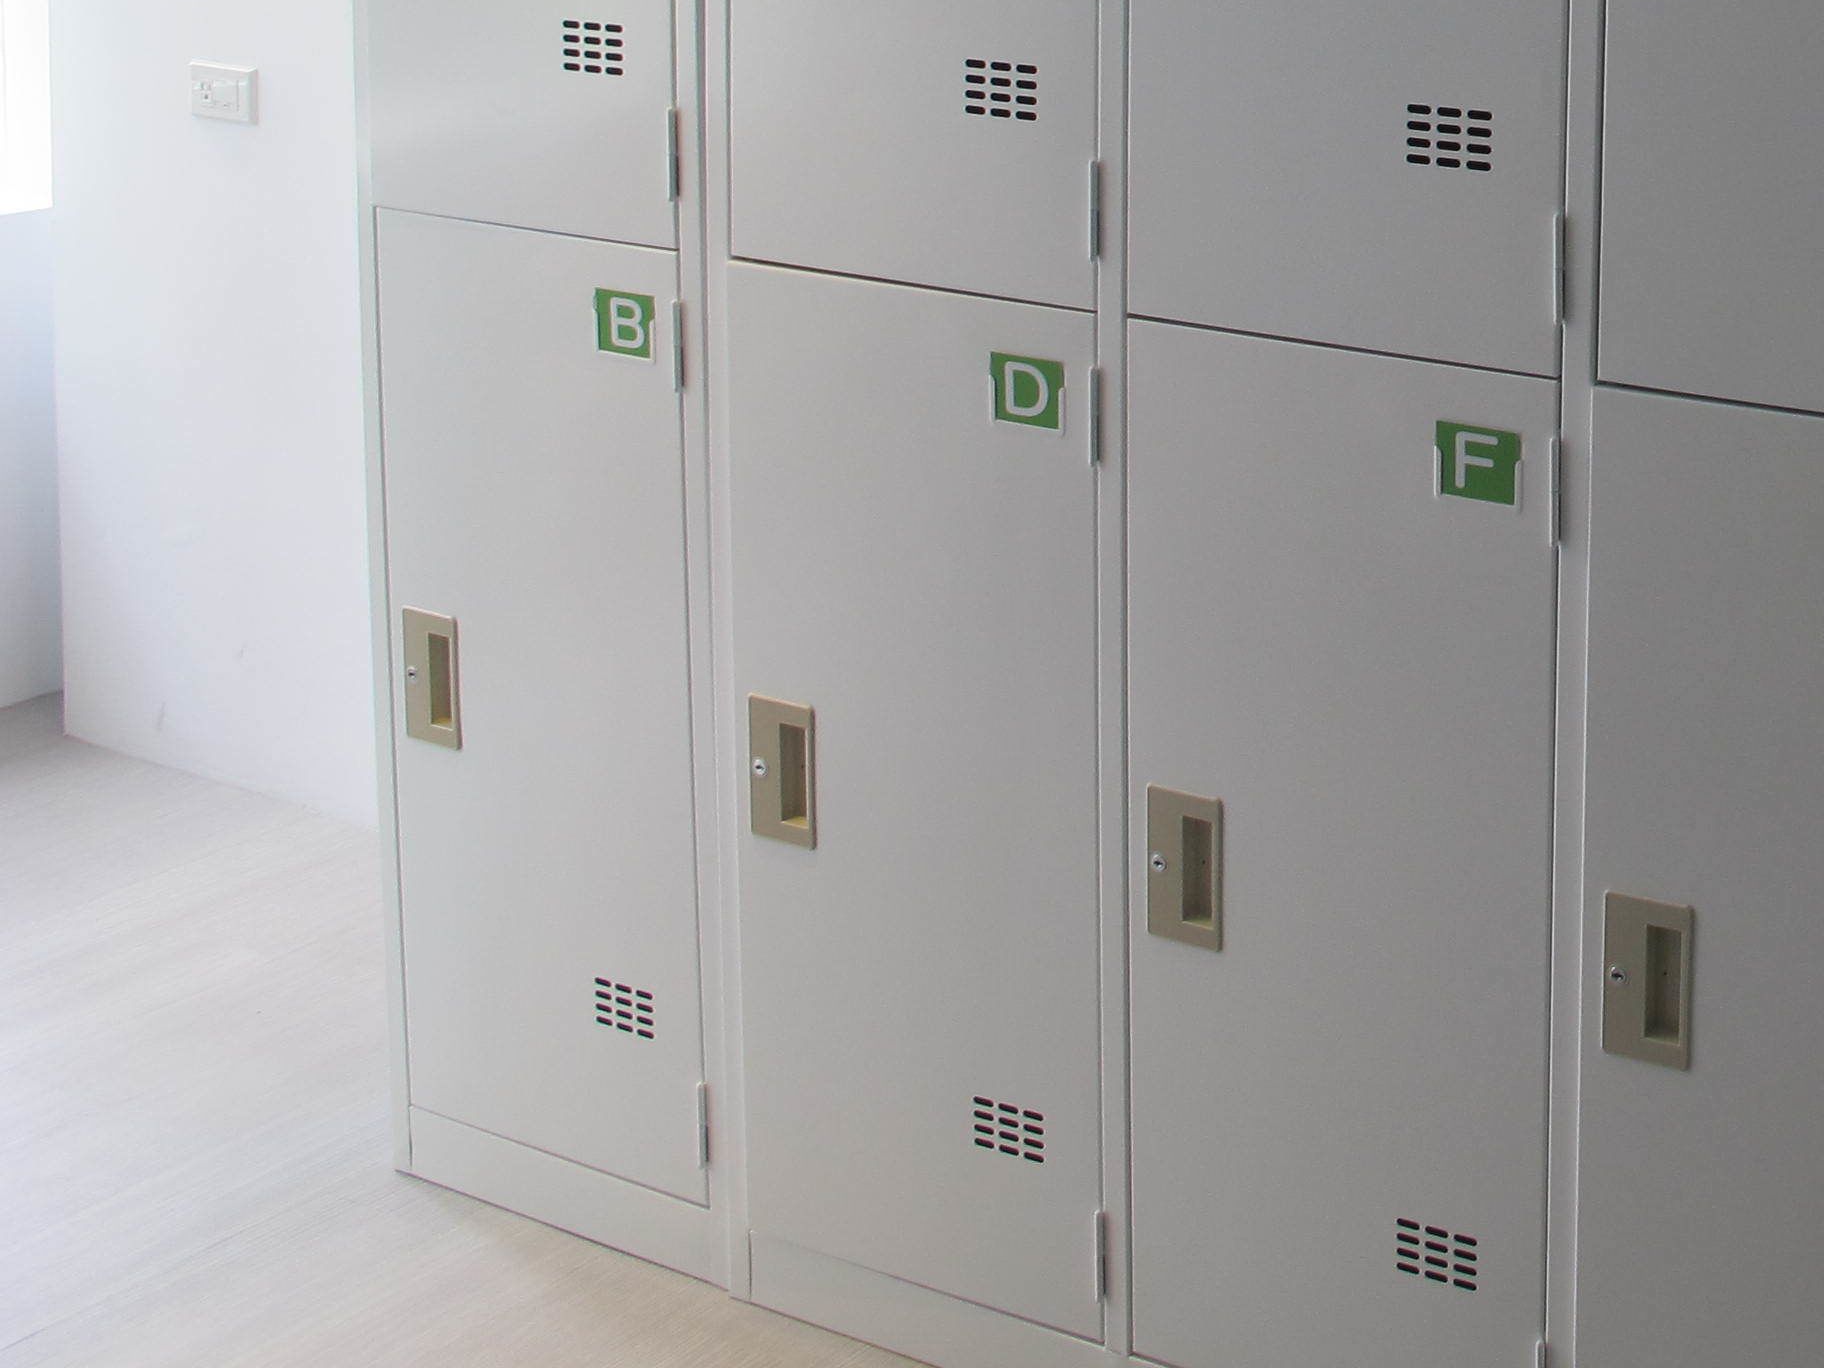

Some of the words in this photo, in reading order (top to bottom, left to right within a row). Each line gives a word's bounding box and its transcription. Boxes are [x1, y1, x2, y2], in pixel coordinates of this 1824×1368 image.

[609, 297, 646, 348] B
[1004, 361, 1049, 416] D
[1455, 431, 1499, 488] F
